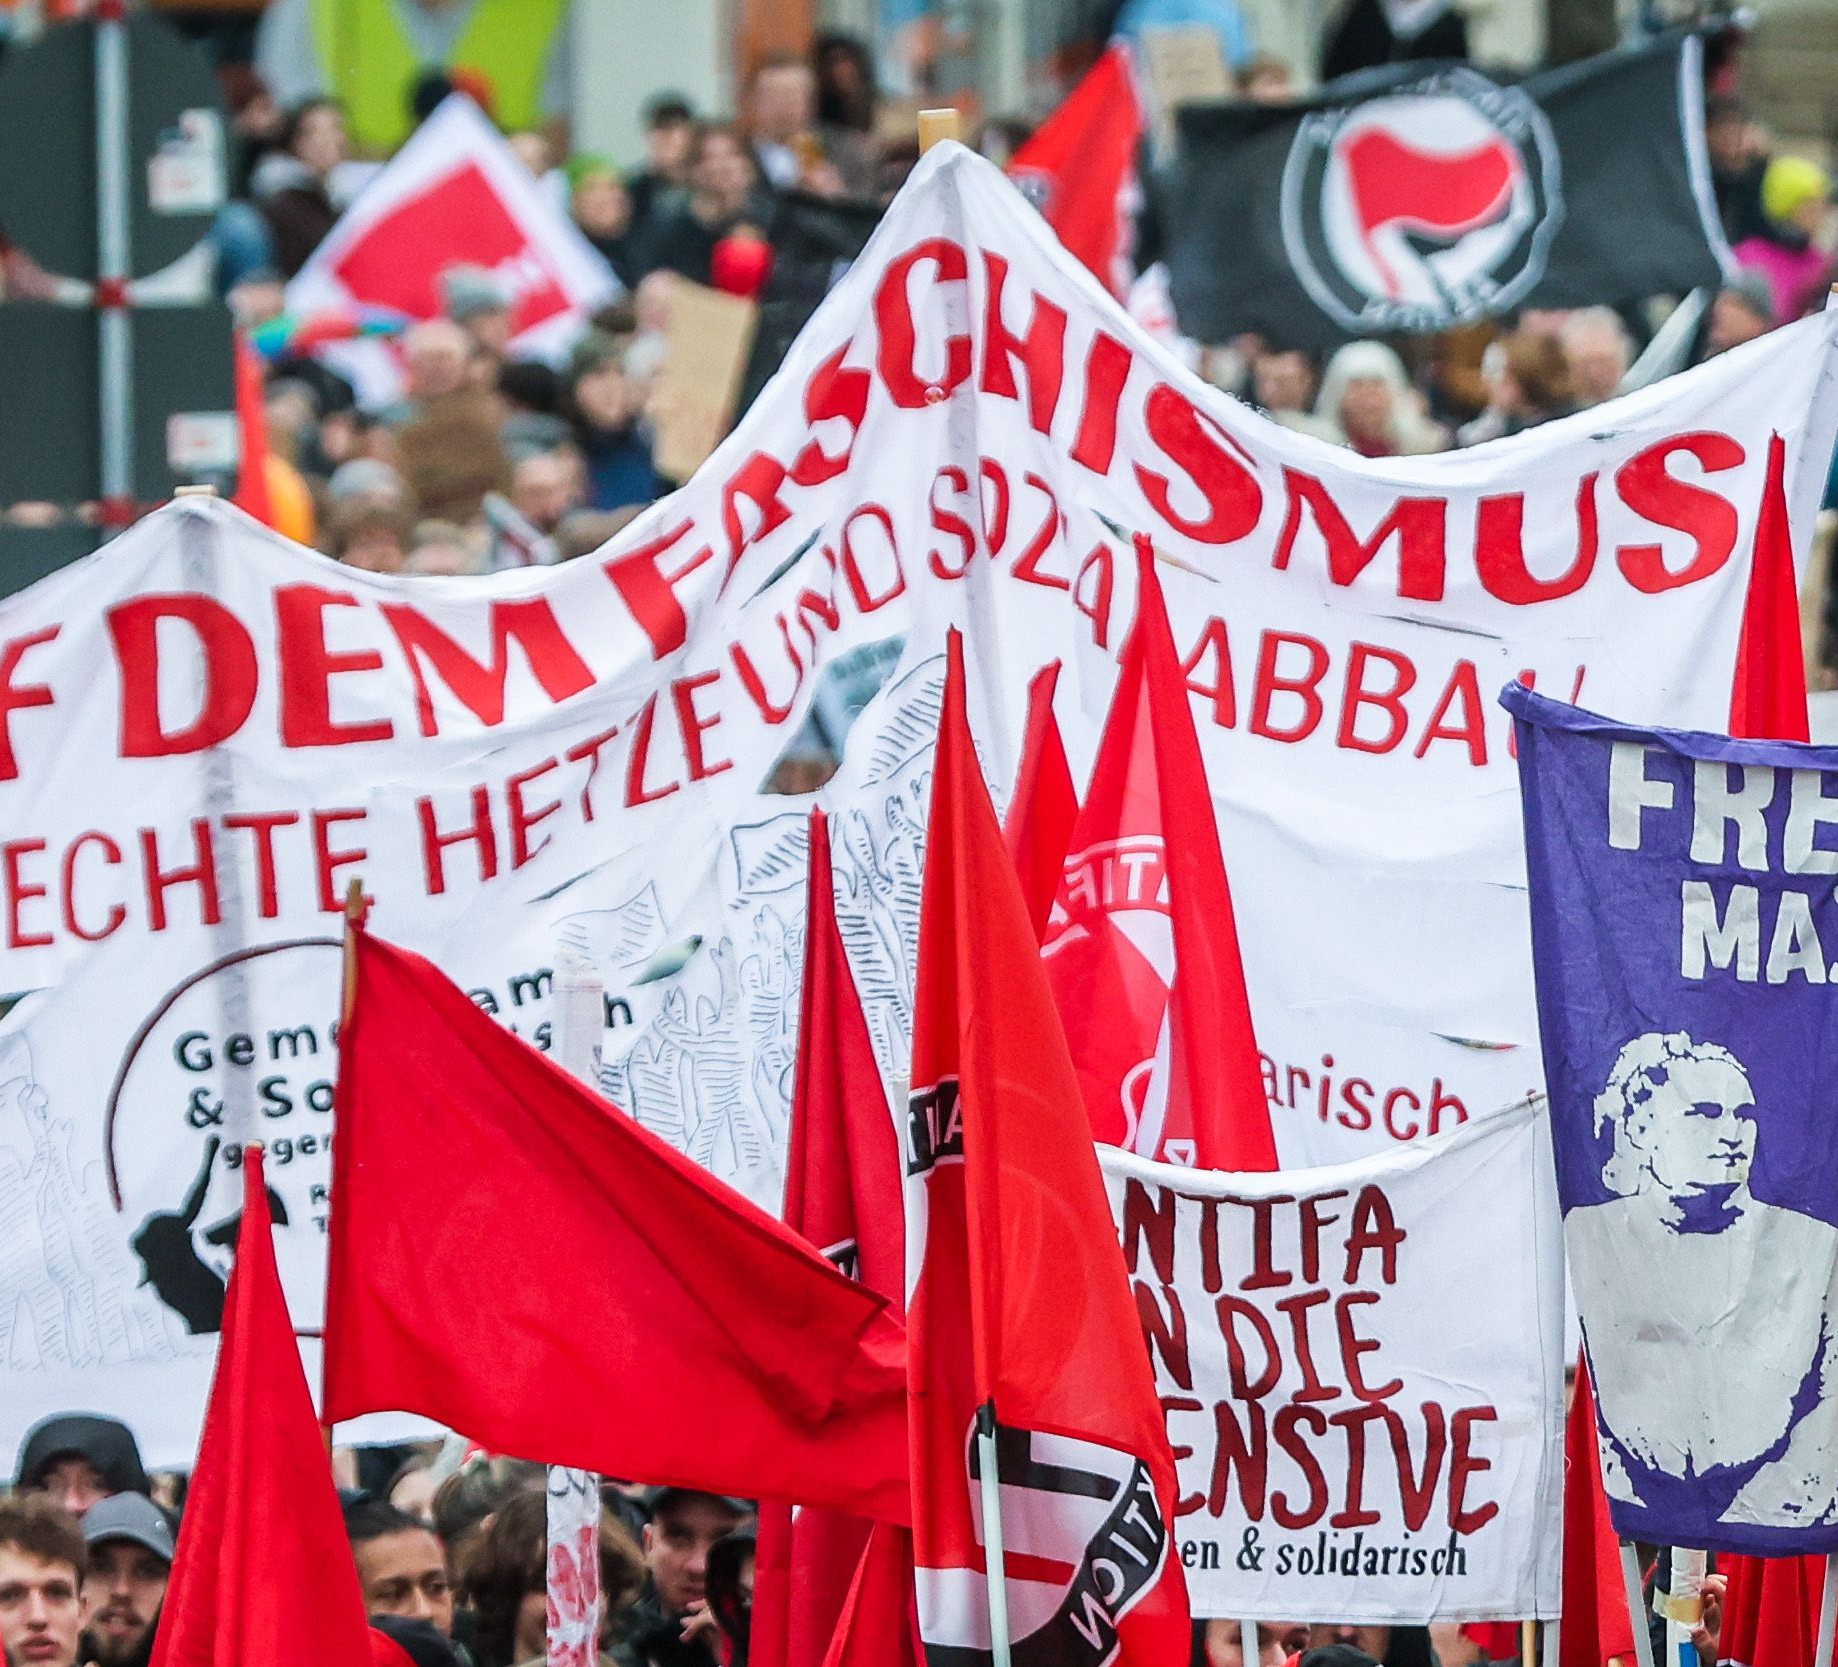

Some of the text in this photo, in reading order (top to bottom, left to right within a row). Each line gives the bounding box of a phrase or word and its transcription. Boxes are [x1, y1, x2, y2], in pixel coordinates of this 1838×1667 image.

[105, 580, 598, 758] DEM
[604, 236, 1749, 660] FASCHISMUS
[416, 667, 734, 897] HETZE
[727, 500, 907, 725] UND
[185, 1086, 224, 1130] &
[1122, 1177, 1407, 1294] NTIFA
[1215, 1289, 1403, 1403] DIE
[1236, 1528, 1265, 1572] &
[1276, 1528, 1468, 1578] solidarisch
